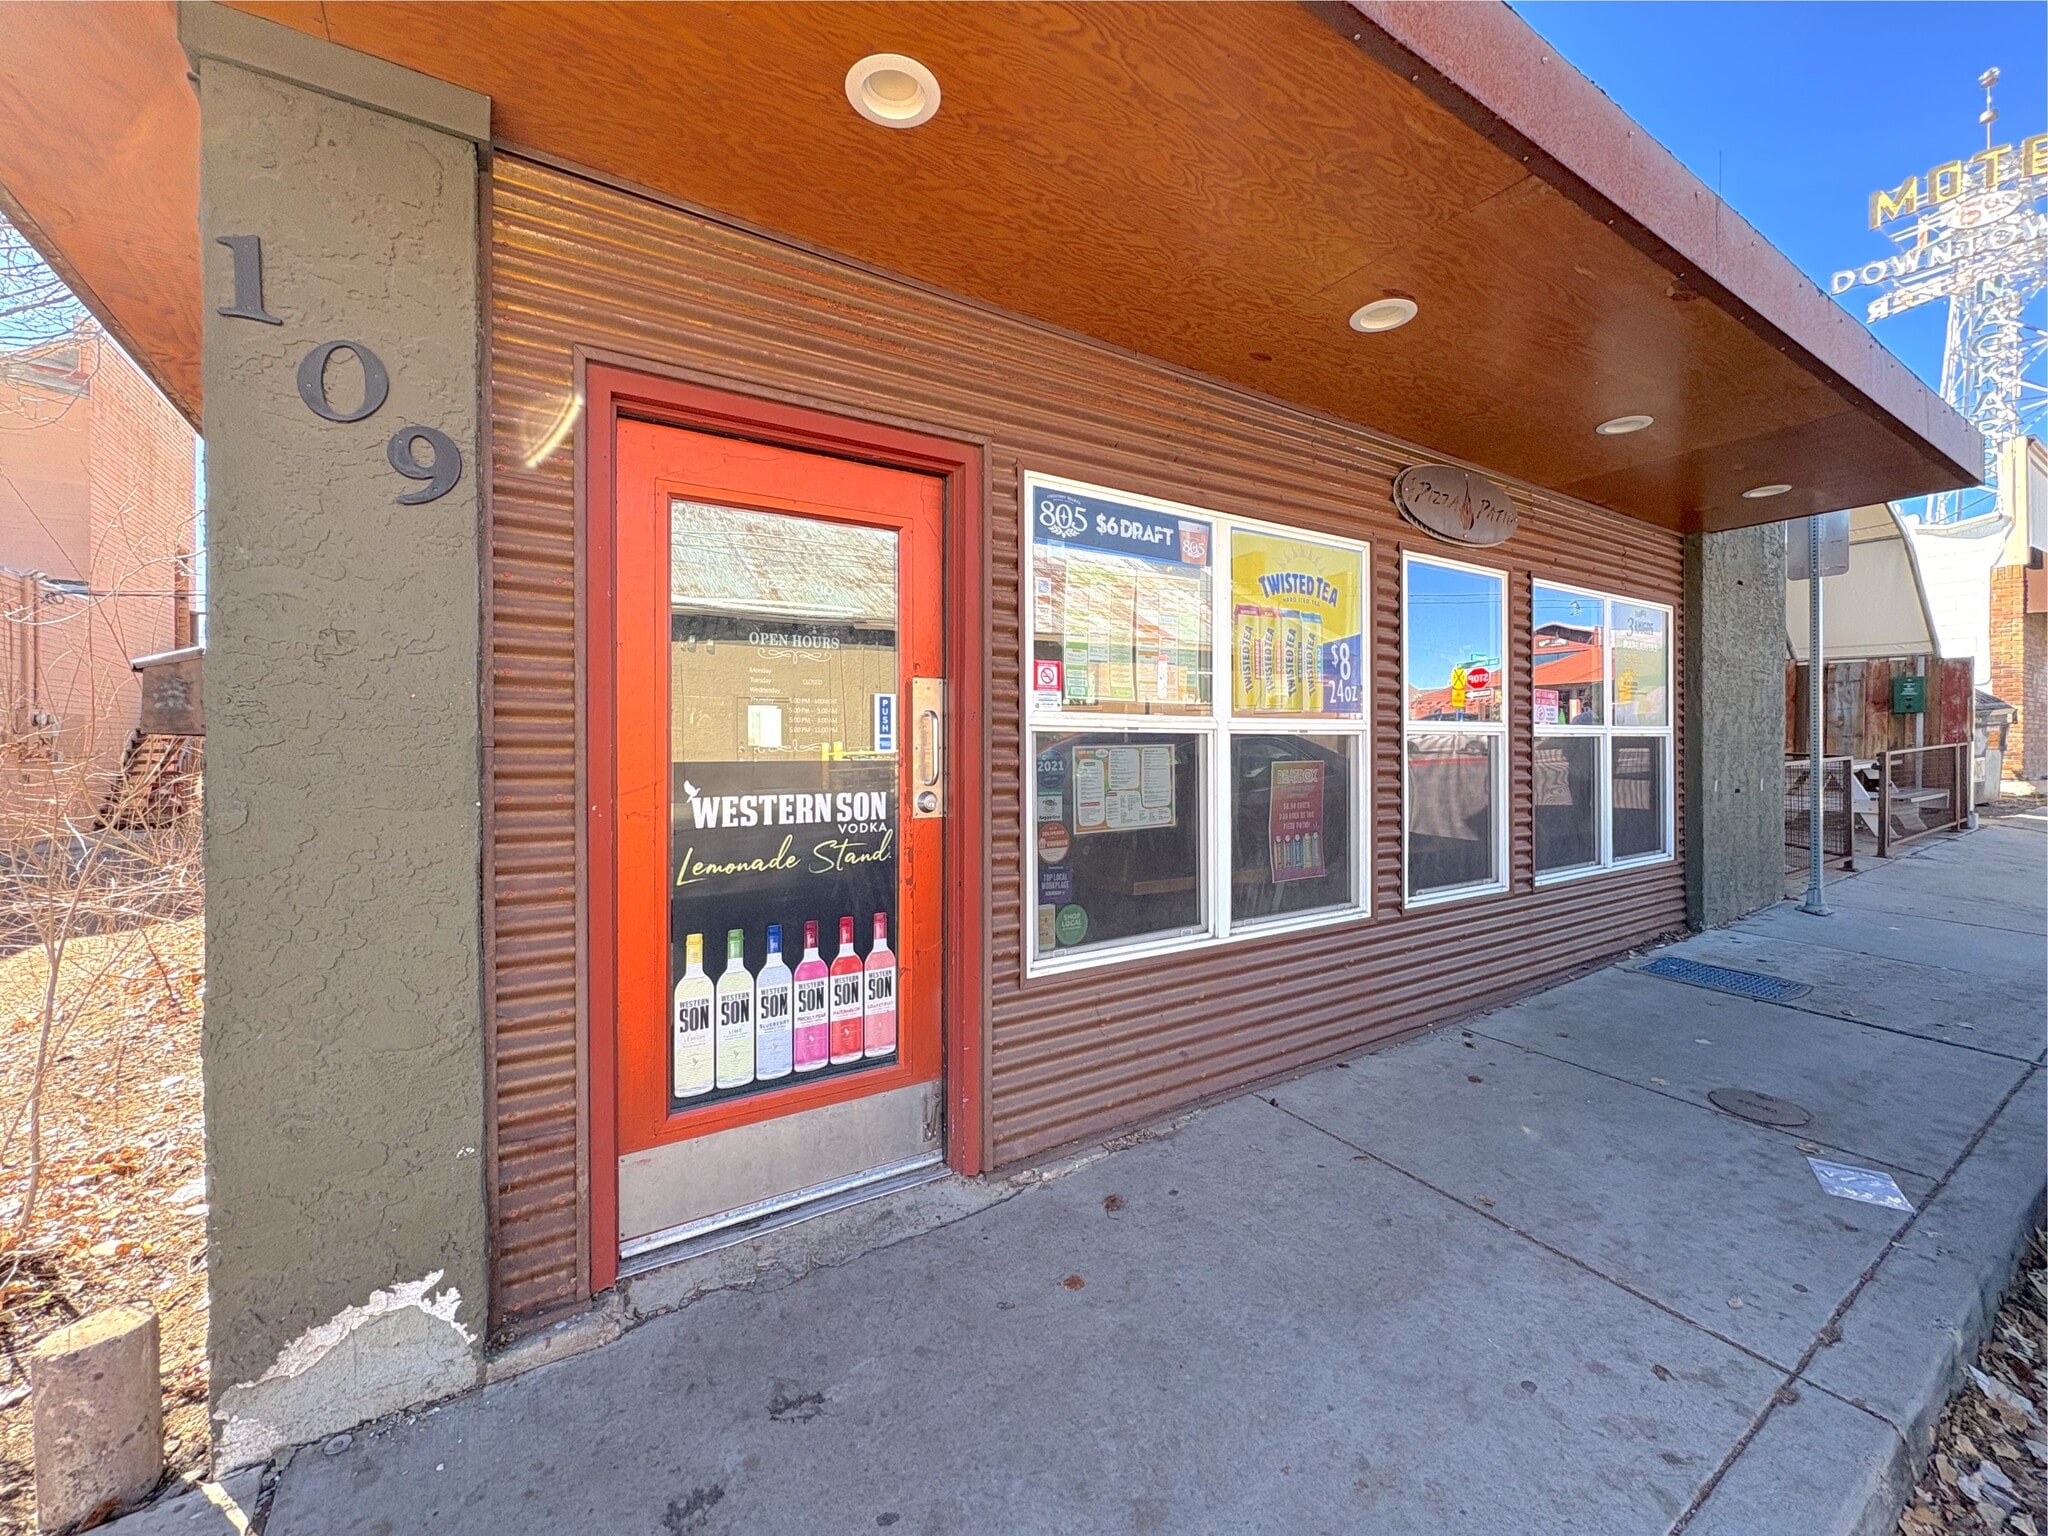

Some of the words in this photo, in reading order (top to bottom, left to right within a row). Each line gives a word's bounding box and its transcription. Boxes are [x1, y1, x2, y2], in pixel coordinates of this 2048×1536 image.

[1414, 481, 1461, 512] PIZZA
[1477, 499, 1516, 527] PATIO
[1039, 500, 1088, 532] 805
[1096, 512, 1119, 536] $6
[1120, 518, 1174, 546] DRAFT
[1182, 539, 1206, 556] 805
[1258, 572, 1315, 599] TWISTED
[1315, 575, 1339, 608] TEA
[1242, 625, 1253, 647] TEA
[1264, 627, 1275, 647] TEA
[1626, 617, 1635, 637] 3
[749, 631, 788, 646] OPEN
[792, 634, 841, 650] HOURS
[1286, 628, 1297, 649] TEA
[1306, 632, 1316, 651] TEA
[749, 667, 772, 675] Monday
[1242, 647, 1254, 694] TWISTED
[1330, 642, 1352, 681] $8
[750, 677, 772, 685] Tuesday
[1285, 649, 1297, 697] TWISTED
[1306, 652, 1315, 696] TWISTED
[1037, 760, 1064, 772] 2021
[691, 793, 832, 829] WESTERN
[836, 791, 887, 822] SON
[837, 822, 888, 834] VODKA
[675, 834, 801, 887] Lemonade
[809, 828, 894, 874] Stand
[1041, 880, 1070, 890] WORKPLACE
[1043, 873, 1053, 882] TOP
[1053, 872, 1068, 881] LOCAL
[1061, 919, 1082, 928] LOCAL
[1063, 912, 1081, 921] SHOP
[834, 975, 859, 985] WESTERN
[869, 969, 892, 978] WESTERN
[761, 986, 788, 996] WESTERN
[798, 980, 824, 990] WESTERN
[834, 981, 859, 1006] SON
[869, 976, 892, 1001] SON
[680, 998, 709, 1009] WESTERN
[721, 992, 749, 1002] WESTERN
[761, 993, 788, 1020] SON
[798, 987, 824, 1013] SON
[680, 1004, 709, 1033] SON
[721, 999, 749, 1026] SON
